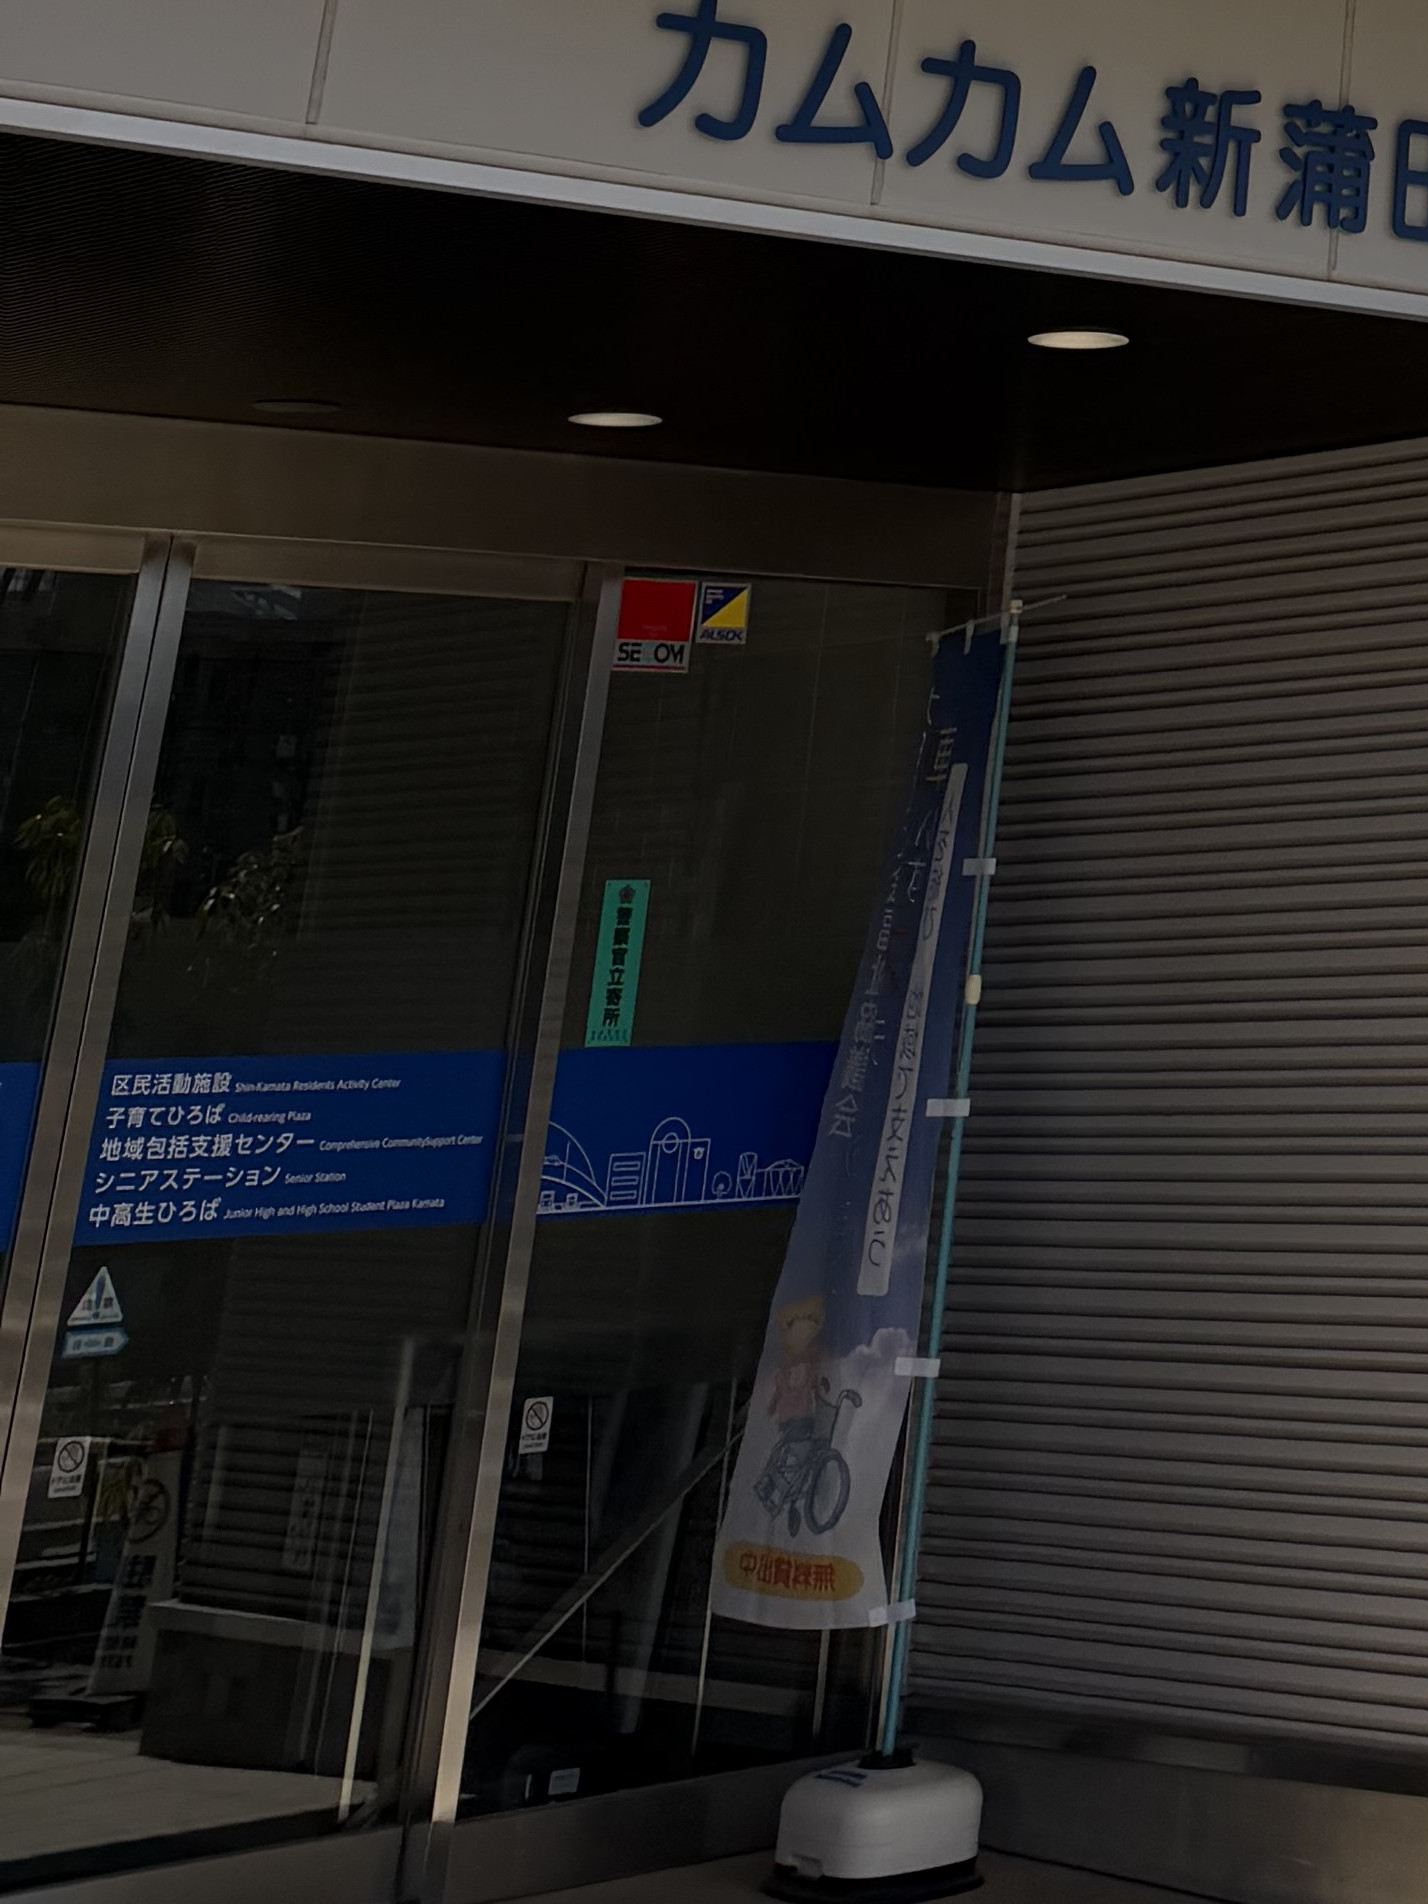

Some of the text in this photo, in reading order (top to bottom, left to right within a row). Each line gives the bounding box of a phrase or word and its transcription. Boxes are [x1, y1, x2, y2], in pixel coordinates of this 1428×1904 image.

[617, 641, 685, 665] SEOM
[111, 1072, 232, 1096] 区民活動施設
[106, 1103, 226, 1128] 子育てひろば
[99, 1132, 315, 1162] 地域包括支援センター
[95, 1166, 281, 1193] シニアステーション
[89, 1197, 222, 1228] 中高生ひろば
